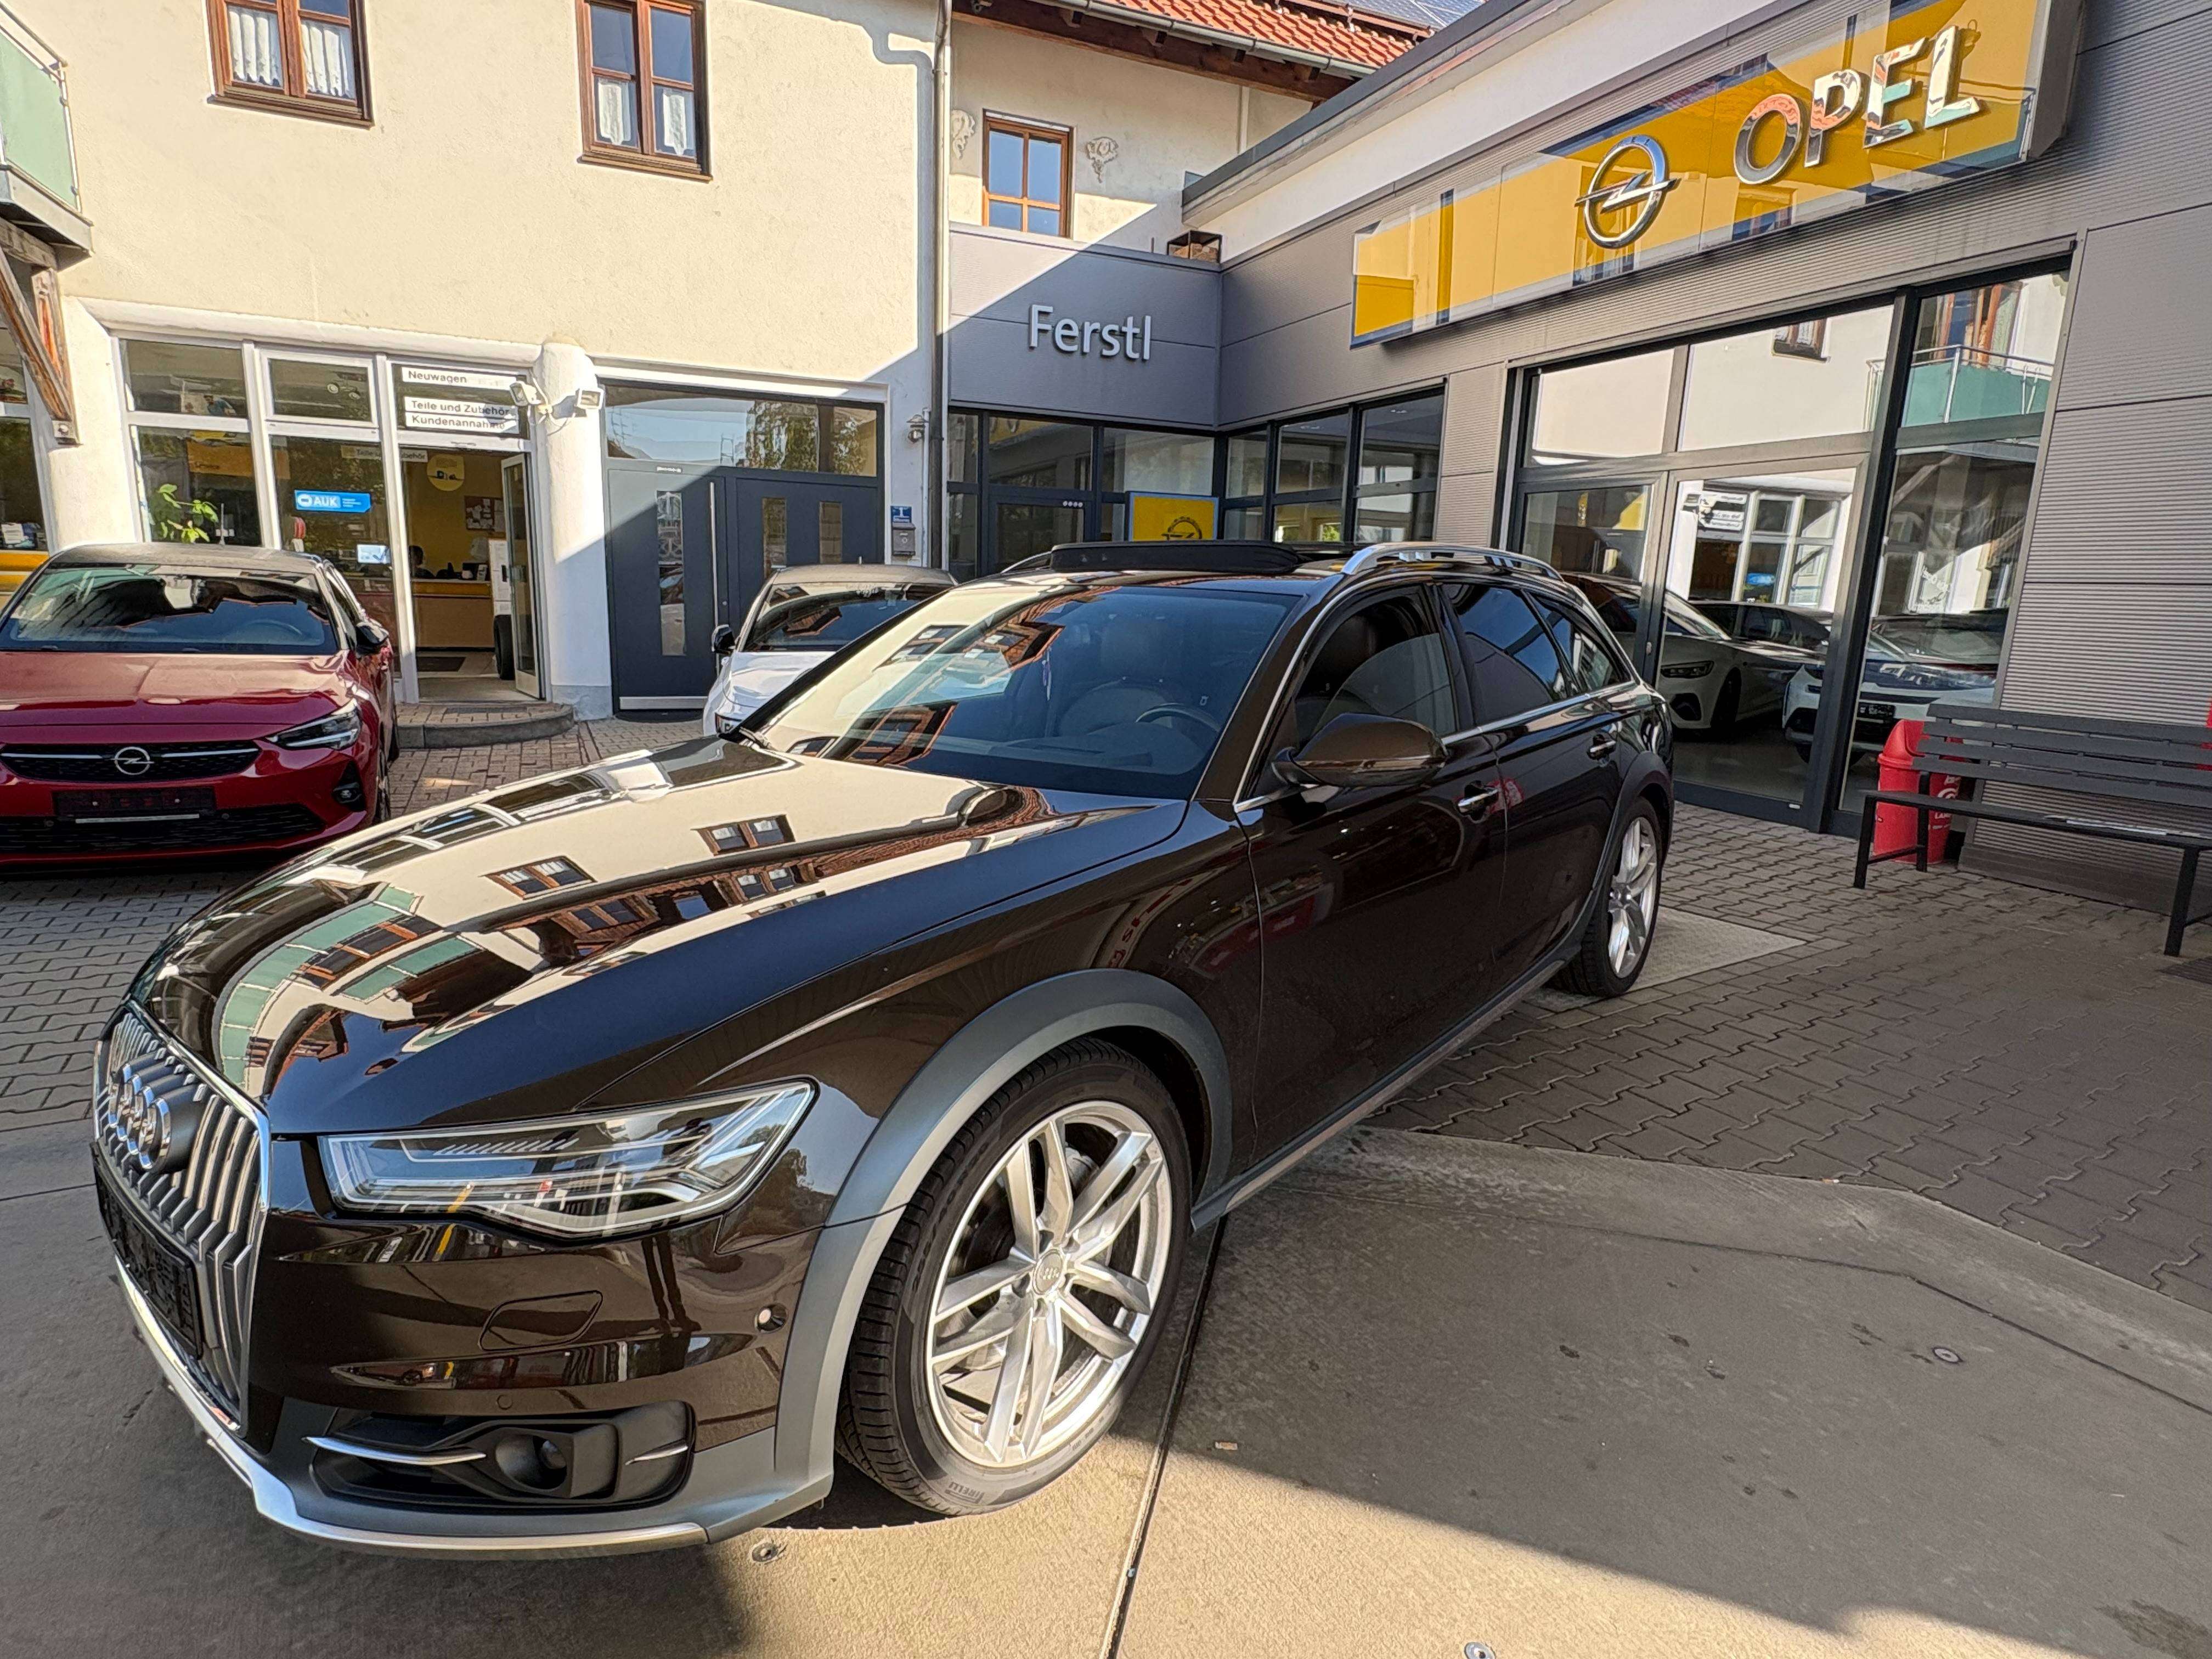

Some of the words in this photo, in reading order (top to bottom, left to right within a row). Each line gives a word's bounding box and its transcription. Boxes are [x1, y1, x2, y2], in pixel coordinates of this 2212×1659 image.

[1733, 25, 1980, 185] OPEL
[1029, 304, 1152, 360] Ferstl
[408, 370, 467, 383] Neuwagen
[412, 400, 437, 410] Teile
[440, 404, 461, 412] und
[464, 405, 509, 416] Zubehör
[412, 415, 505, 429] Kundenannahme
[313, 495, 337, 507] AUK
[944, 1481, 985, 1504] PIRELLI
